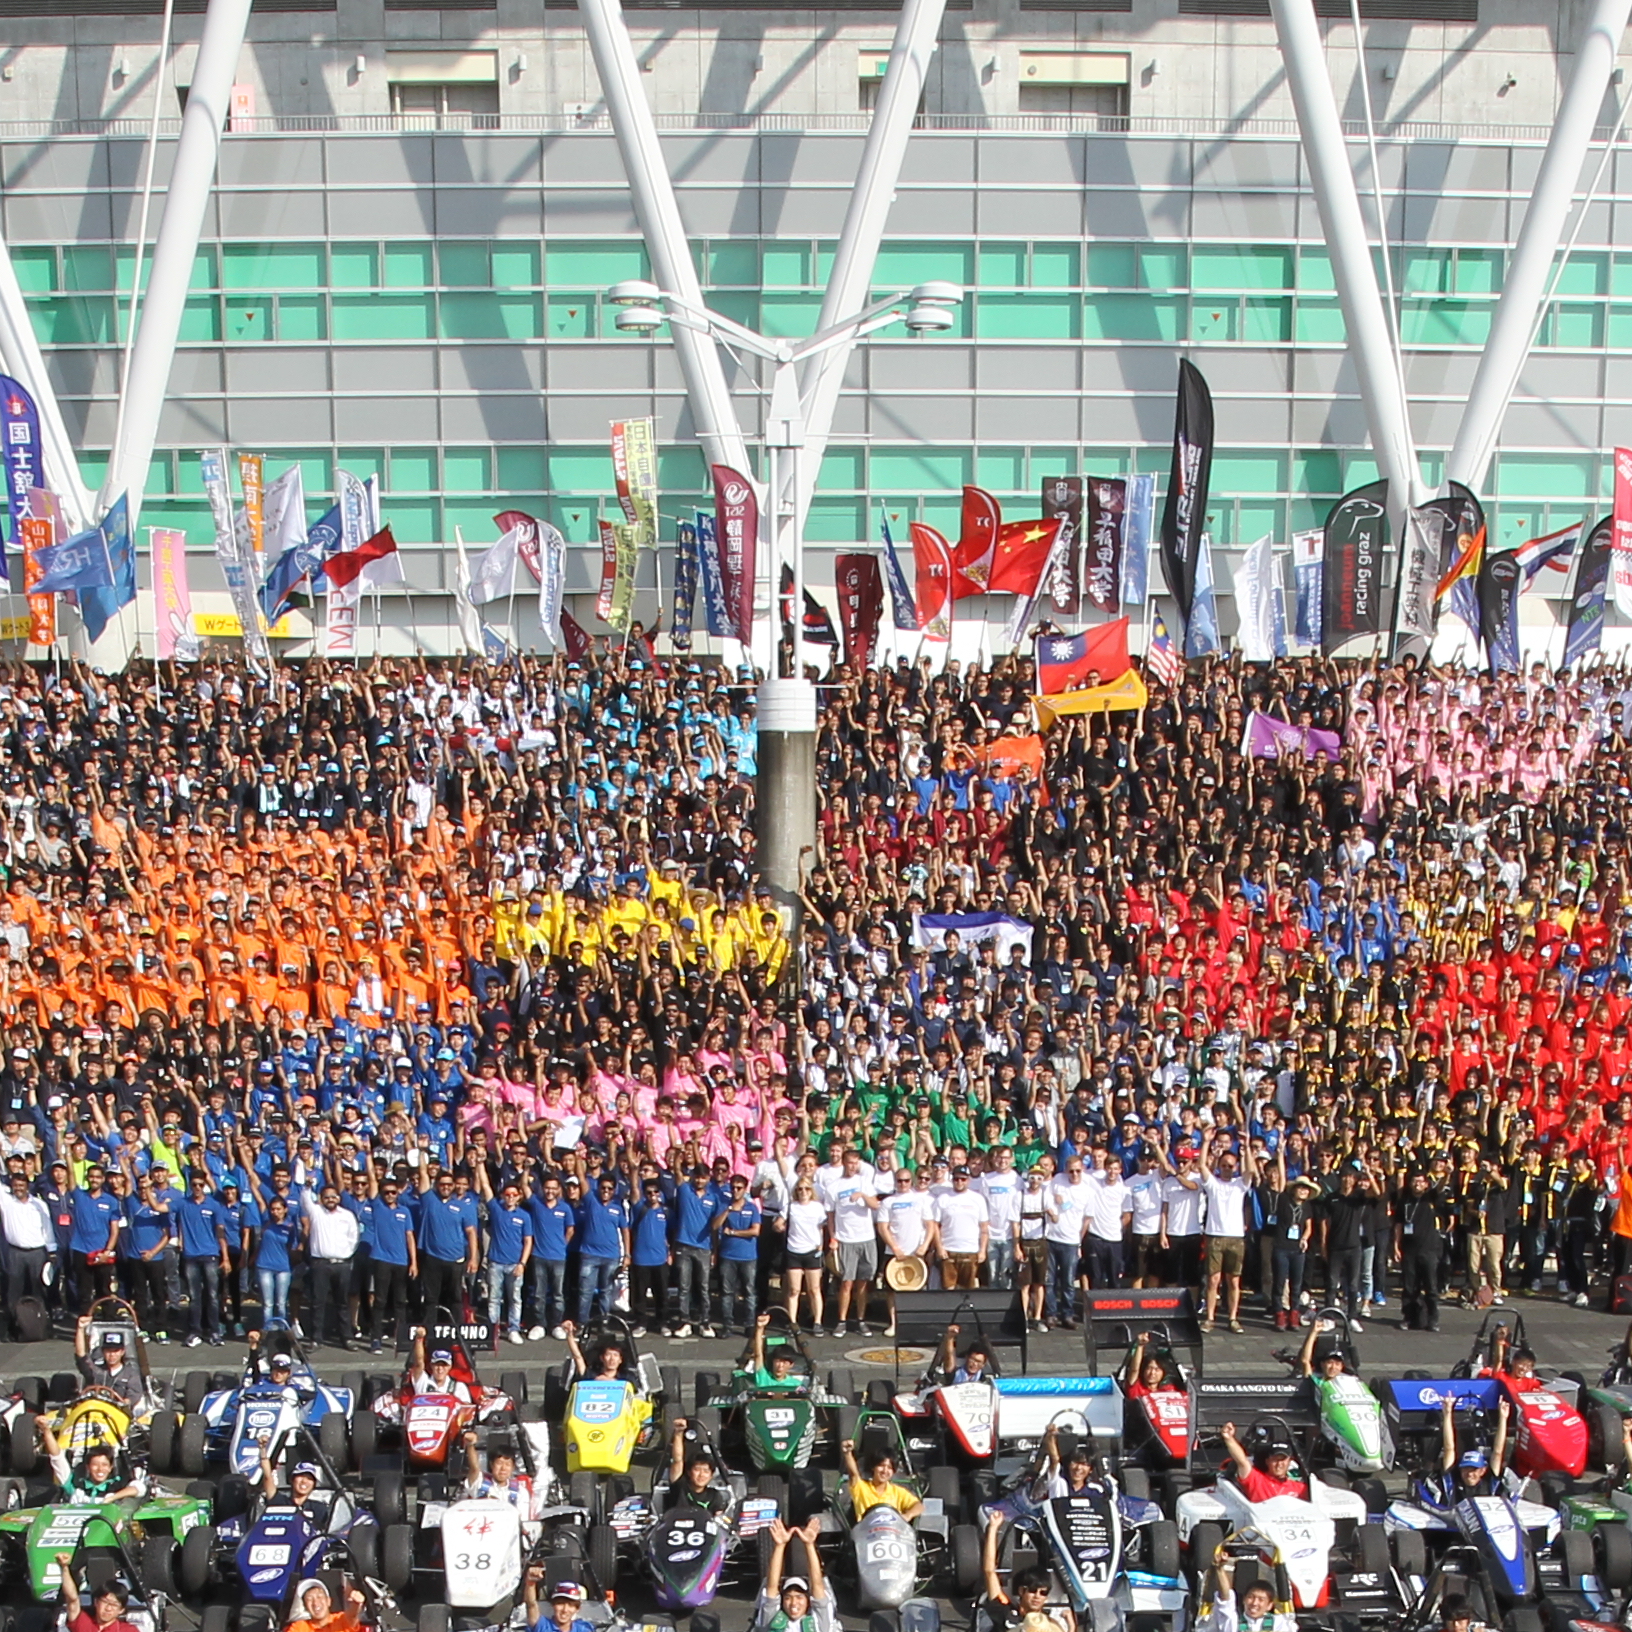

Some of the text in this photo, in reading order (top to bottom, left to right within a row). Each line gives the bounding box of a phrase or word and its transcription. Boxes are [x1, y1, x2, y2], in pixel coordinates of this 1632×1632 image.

[1089, 511, 1114, 604] 早稲田大学
[1356, 532, 1372, 616] racing graz
[1093, 1299, 1180, 1310] BOSCH BOSCH
[1201, 1383, 1231, 1393] OSAKA
[1233, 1383, 1276, 1393] SANGYO
[416, 1407, 444, 1418] 24
[581, 1402, 614, 1413] 82
[770, 1410, 789, 1420] 31
[968, 1413, 992, 1424] 70
[1348, 1410, 1377, 1422] 30
[247, 1427, 271, 1441] 18
[667, 1530, 706, 1547] 36
[1284, 1528, 1311, 1541] 34
[254, 1547, 285, 1562] 68
[871, 1542, 903, 1561] 60
[453, 1552, 493, 1571] 38
[1081, 1561, 1108, 1582] 21
